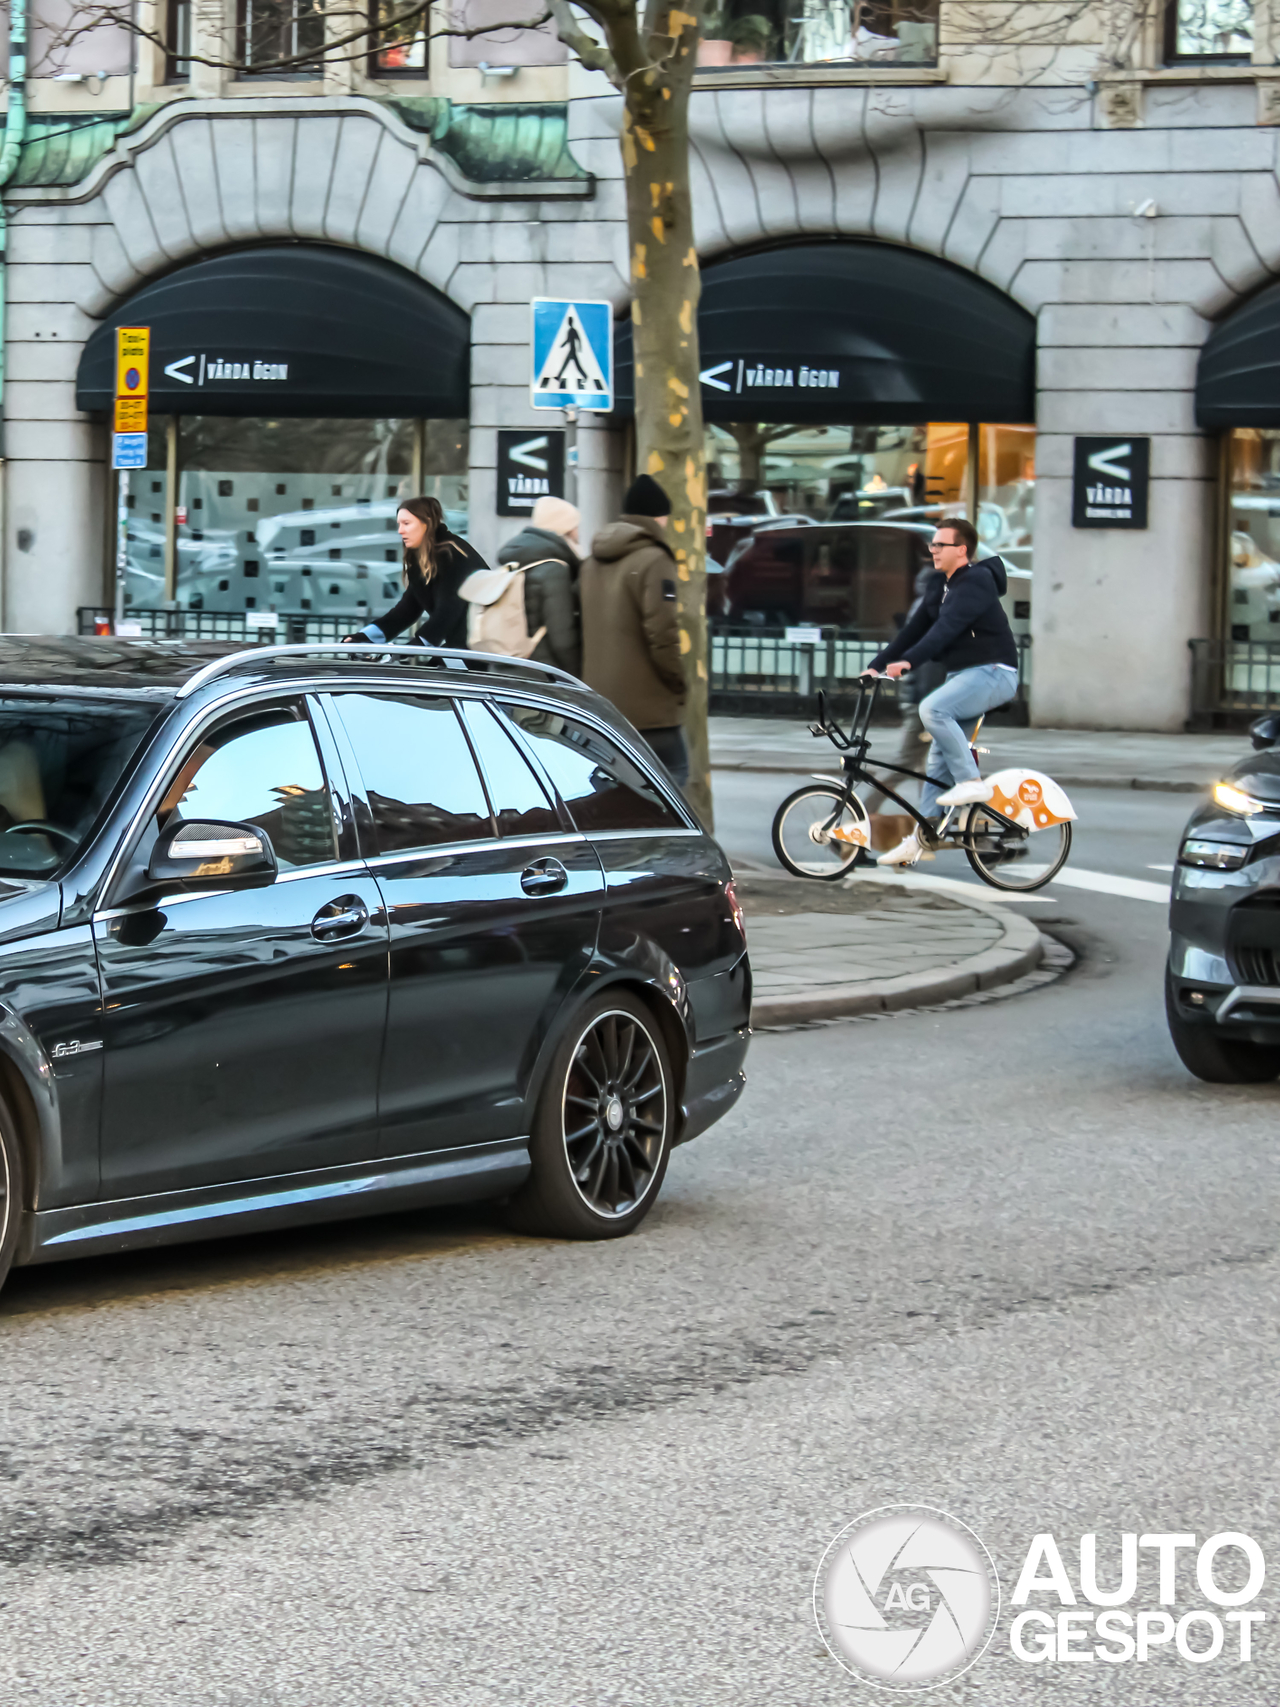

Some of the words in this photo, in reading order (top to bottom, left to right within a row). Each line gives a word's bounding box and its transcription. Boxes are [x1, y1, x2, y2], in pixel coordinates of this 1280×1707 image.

[746, 363, 794, 387] VÅRDA
[798, 365, 840, 389] ÖGON
[508, 473, 550, 494] VÅRDA
[1086, 482, 1133, 505] VÅRDA
